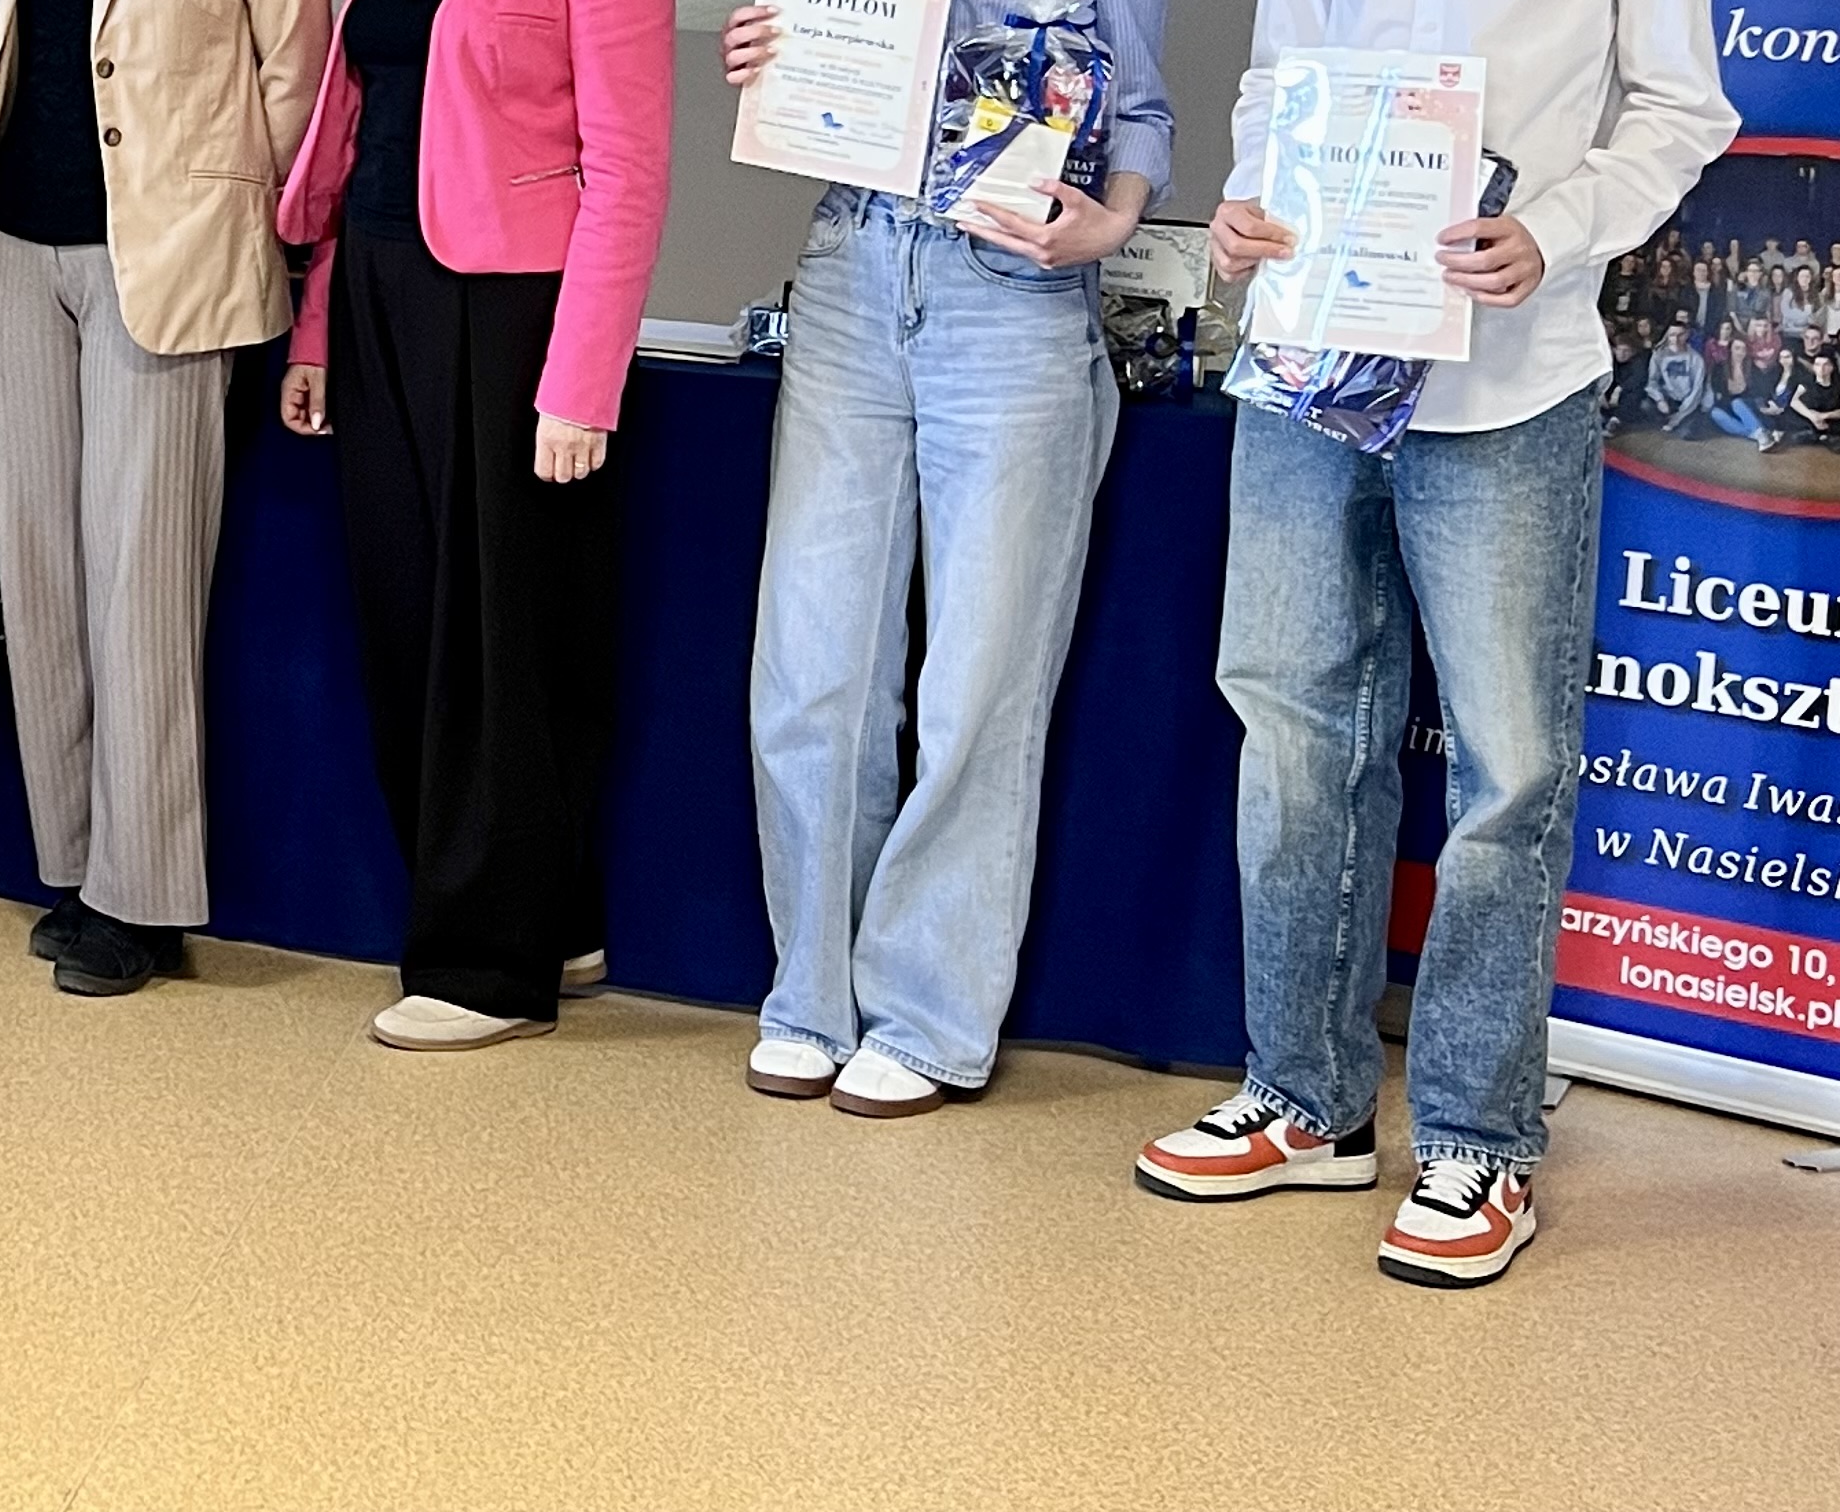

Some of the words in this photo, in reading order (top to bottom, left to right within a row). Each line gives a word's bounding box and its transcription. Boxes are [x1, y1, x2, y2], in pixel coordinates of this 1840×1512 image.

[1722, 7, 1840, 64] kon
[1618, 550, 1840, 638] Liceu
[1584, 650, 1840, 735] nokszt
[1743, 773, 1840, 826] Iwa
[1595, 827, 1632, 858] w
[1643, 828, 1840, 900] Nasiels
[1560, 906, 1774, 971] arzyńskiego
[1788, 944, 1836, 987] 10,
[1619, 955, 1840, 1031] lonasielsk.pl
